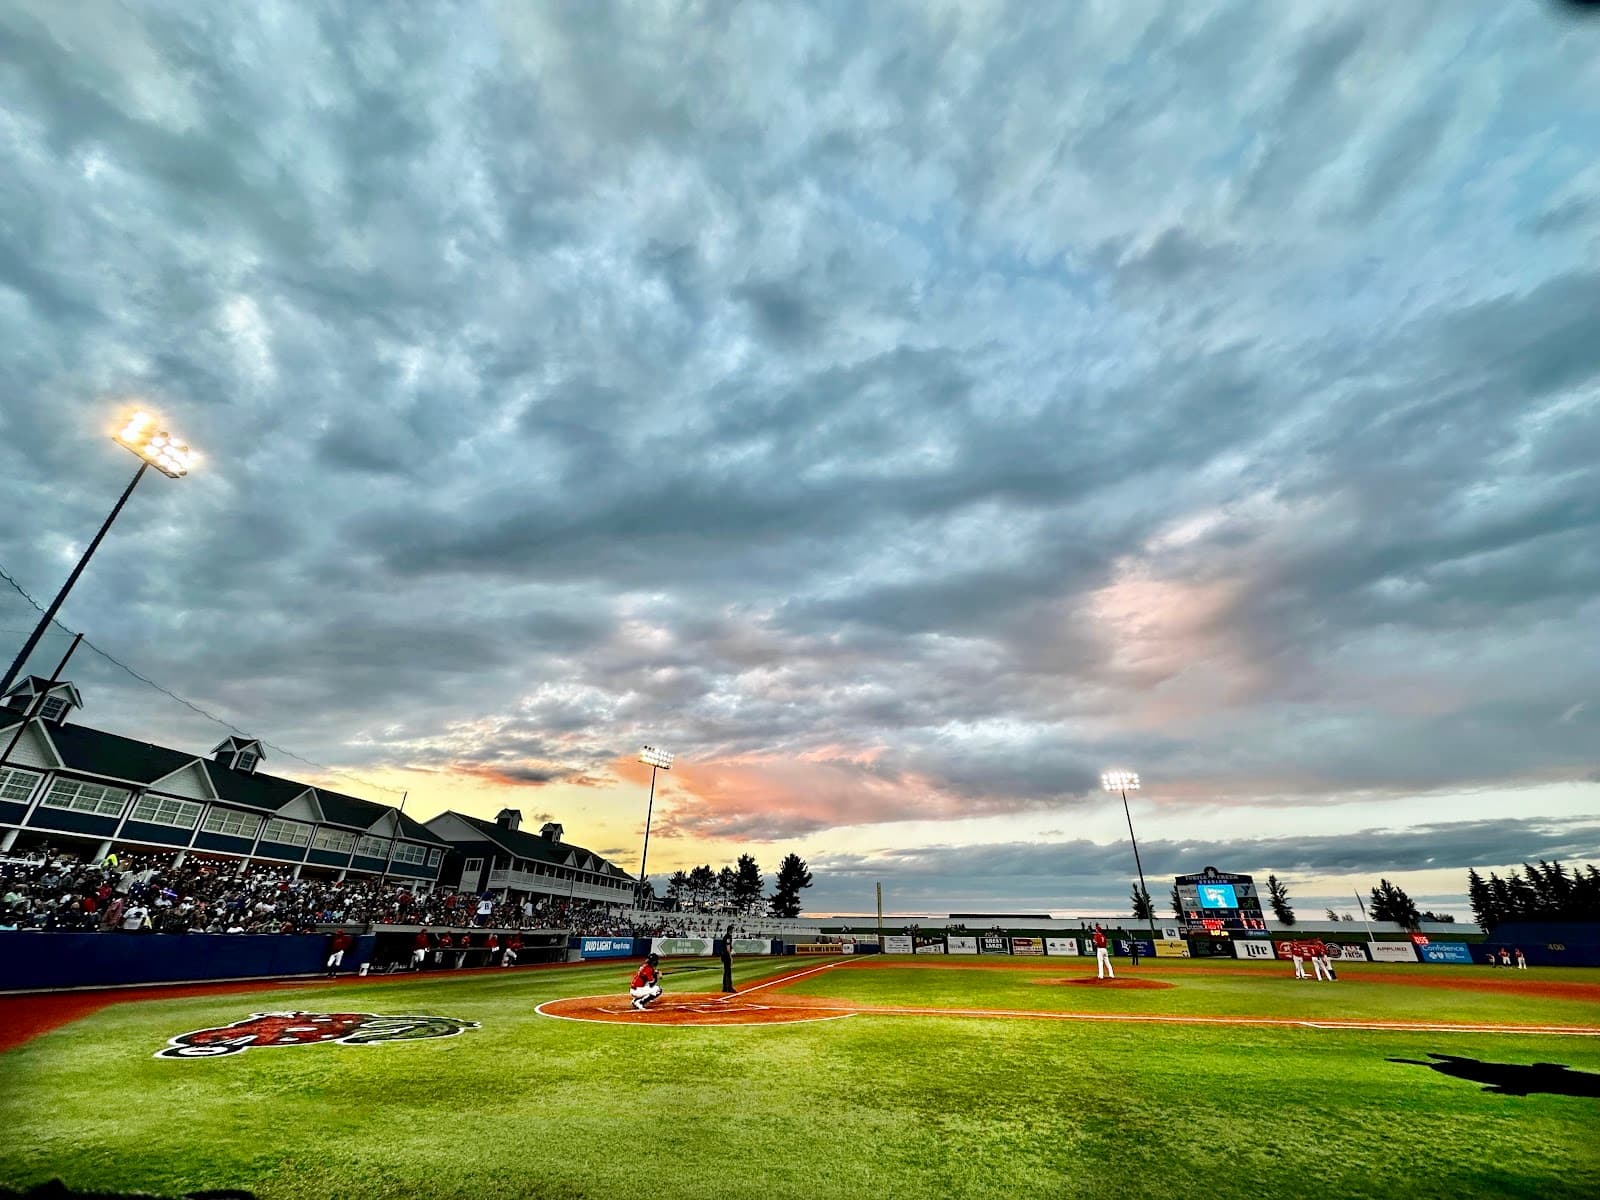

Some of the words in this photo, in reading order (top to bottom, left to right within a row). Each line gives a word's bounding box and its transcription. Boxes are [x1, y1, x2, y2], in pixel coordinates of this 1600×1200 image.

[585, 941, 597, 951] BUD
[597, 941, 612, 950] LIGHT
[1245, 944, 1268, 957] Lite
